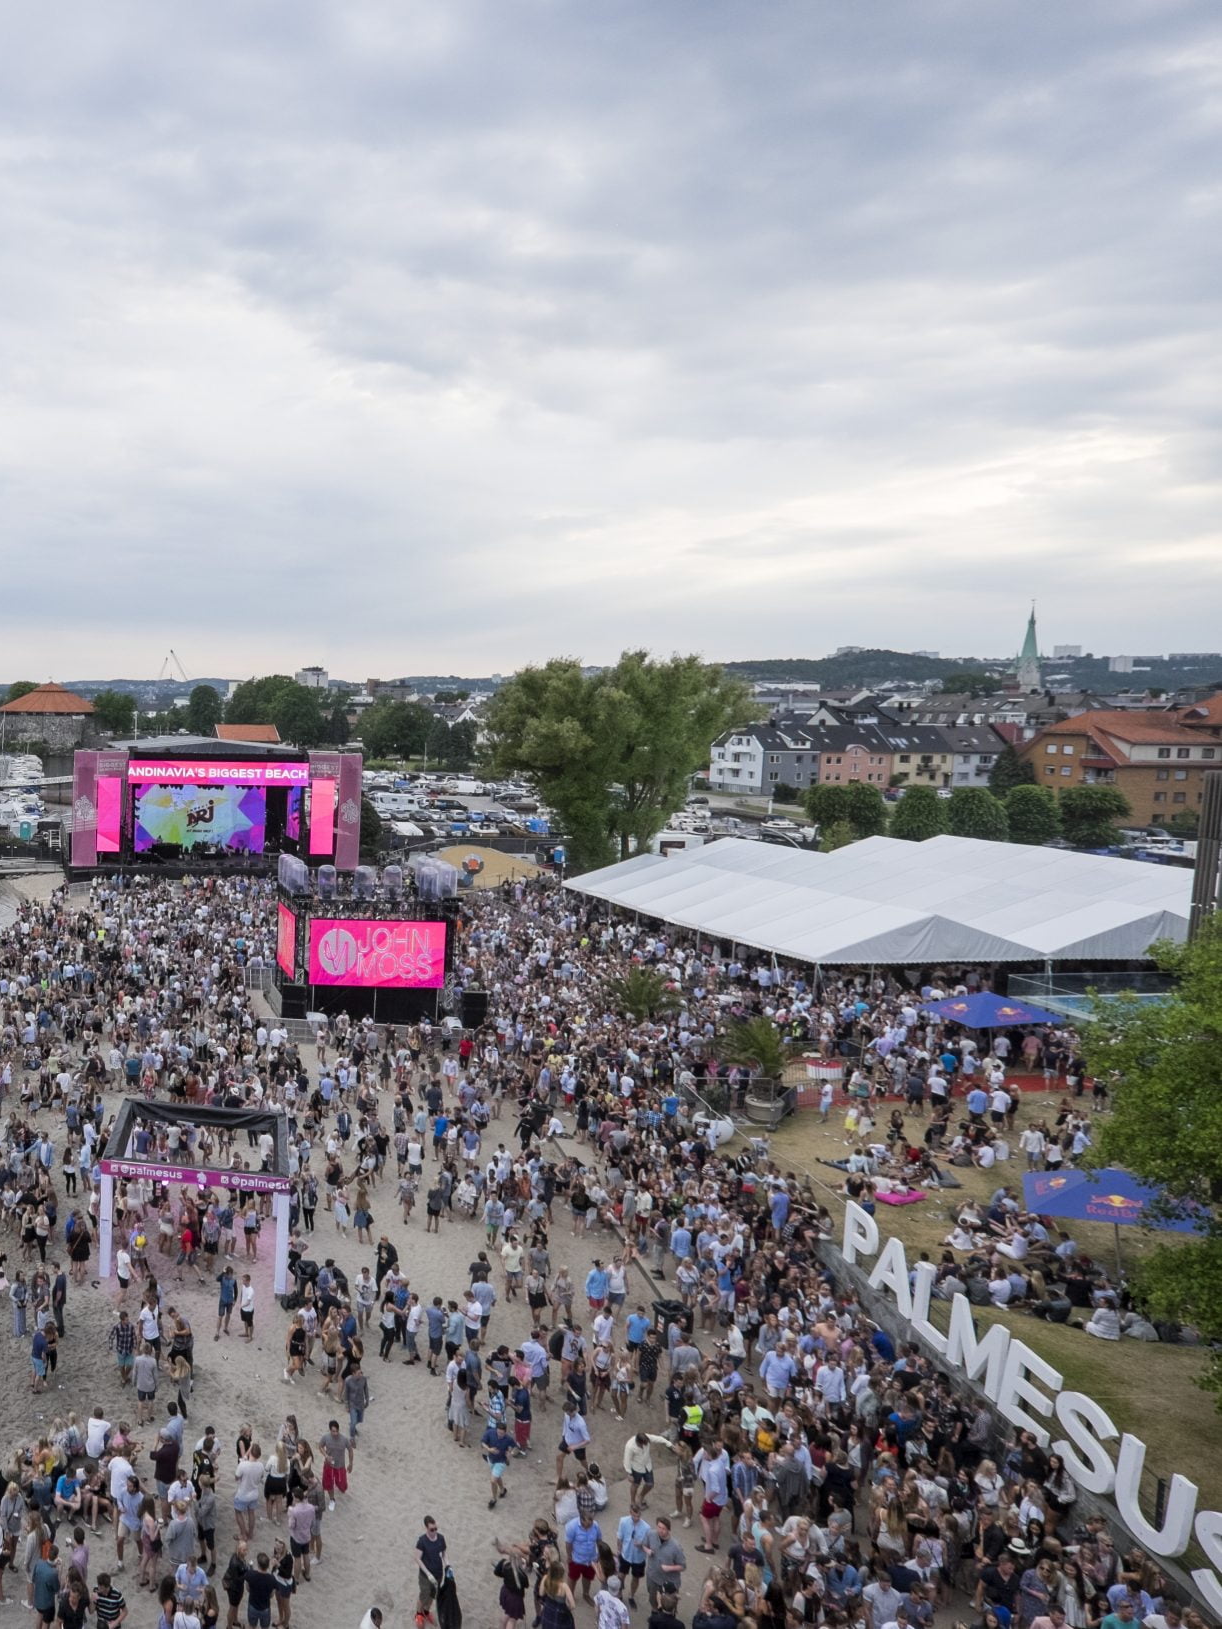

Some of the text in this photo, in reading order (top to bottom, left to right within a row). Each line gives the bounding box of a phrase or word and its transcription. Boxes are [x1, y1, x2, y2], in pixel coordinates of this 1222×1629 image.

[128, 766, 205, 778] ANDINAVIA'S
[209, 768, 262, 778] BIGGEST
[265, 768, 308, 779] BEACH
[357, 927, 431, 954] JOHN
[356, 951, 433, 979] MOSS
[120, 1166, 183, 1179] @palmesus
